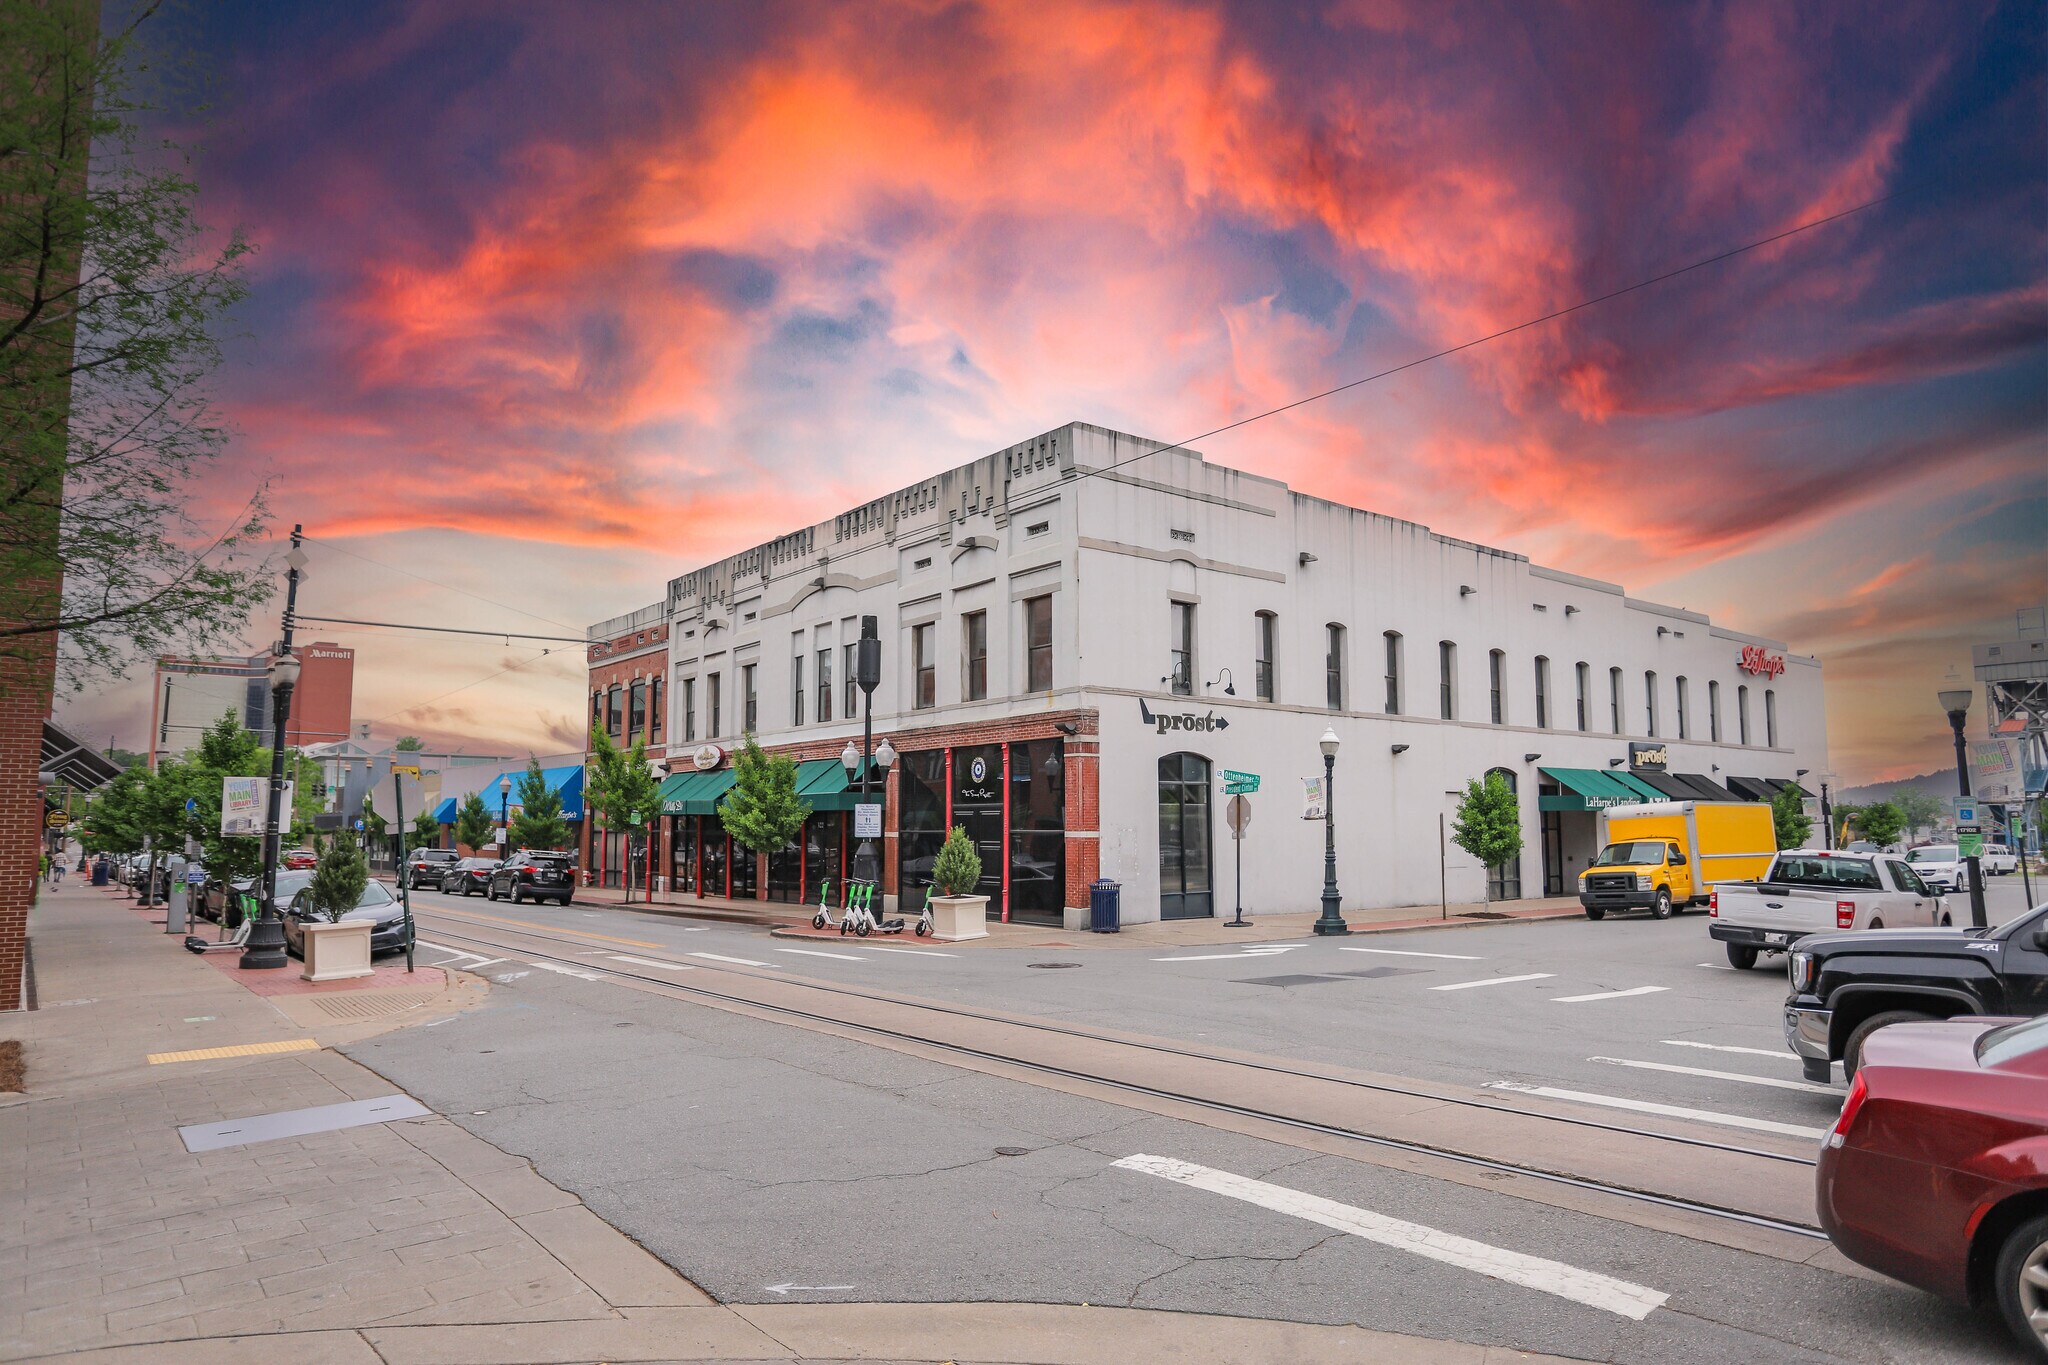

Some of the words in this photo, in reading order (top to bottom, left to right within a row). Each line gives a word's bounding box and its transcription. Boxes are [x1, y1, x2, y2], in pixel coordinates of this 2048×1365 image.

[310, 649, 350, 659] Marriott
[1976, 753, 2003, 766] MAIN
[1978, 764, 2005, 773] LIBRARY
[1225, 771, 1254, 782] Ottenheimer
[228, 781, 250, 791] YOUR
[229, 790, 252, 802] MAIN
[230, 800, 252, 808] LIBRARY
